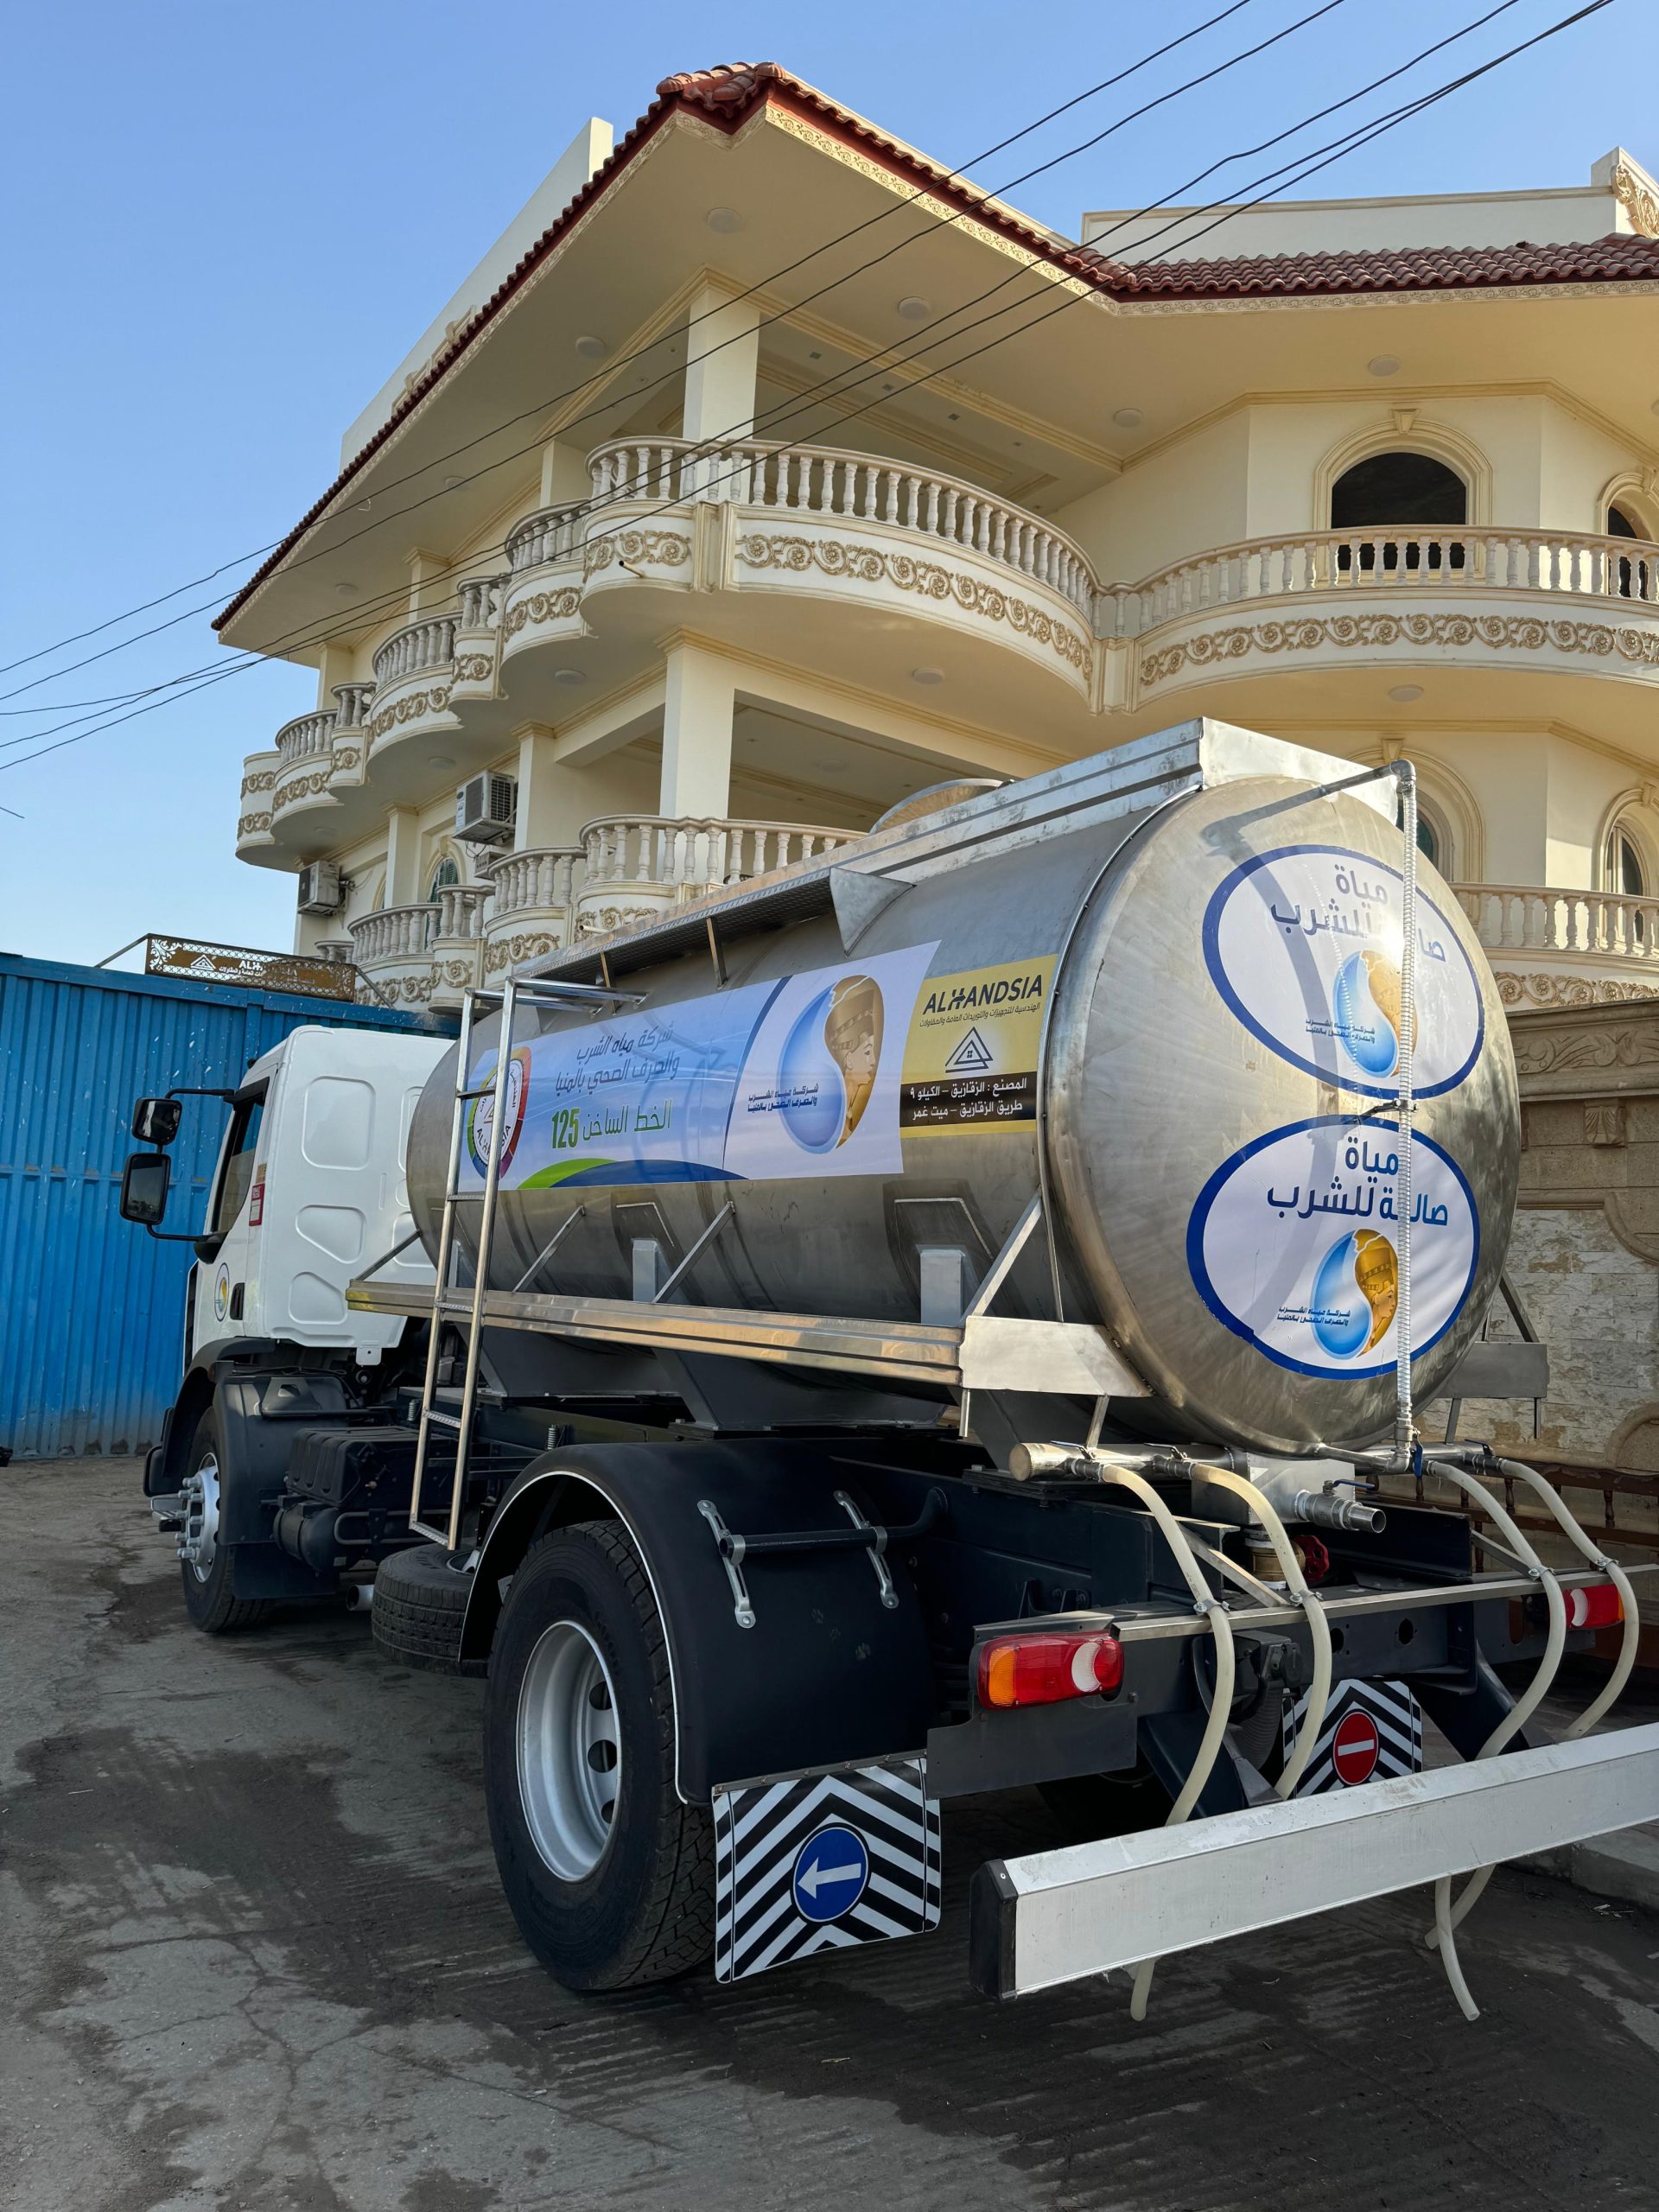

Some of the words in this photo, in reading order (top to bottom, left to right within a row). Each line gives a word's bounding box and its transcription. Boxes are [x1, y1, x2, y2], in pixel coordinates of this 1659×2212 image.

[1334, 864, 1388, 910] مياة
[923, 975, 1042, 1014] ALHANDSIA
[946, 1014, 963, 1023] العامة
[963, 1010, 989, 1022] والتوريدات
[989, 1006, 1014, 1018] للتجهيزات
[1015, 1002, 1040, 1014] الهندسية
[919, 1017, 945, 1028] والمقاولات
[611, 1032, 635, 1057] مياه
[638, 1021, 675, 1052] شركة
[576, 1036, 613, 1065] الشرب
[587, 1058, 632, 1095] الصحي
[632, 1050, 681, 1084] والصرف
[555, 1068, 587, 1096] بالمنيا
[918, 1085, 940, 1101] الكيلو
[950, 1081, 985, 1099] الزقازيق
[993, 1077, 1027, 1097] المصنع
[634, 1099, 672, 1132] الخط
[912, 1105, 928, 1121] غمر
[931, 1105, 949, 1120] ميت
[959, 1101, 994, 1118] الزقازيق
[996, 1098, 1023, 1116] طريق
[551, 1108, 581, 1149] 125
[582, 1105, 629, 1141] الساخن
[1345, 1136, 1399, 1183] مياة
[1268, 1176, 1374, 1218] للشرب
[1380, 1186, 1448, 1226] صالة
